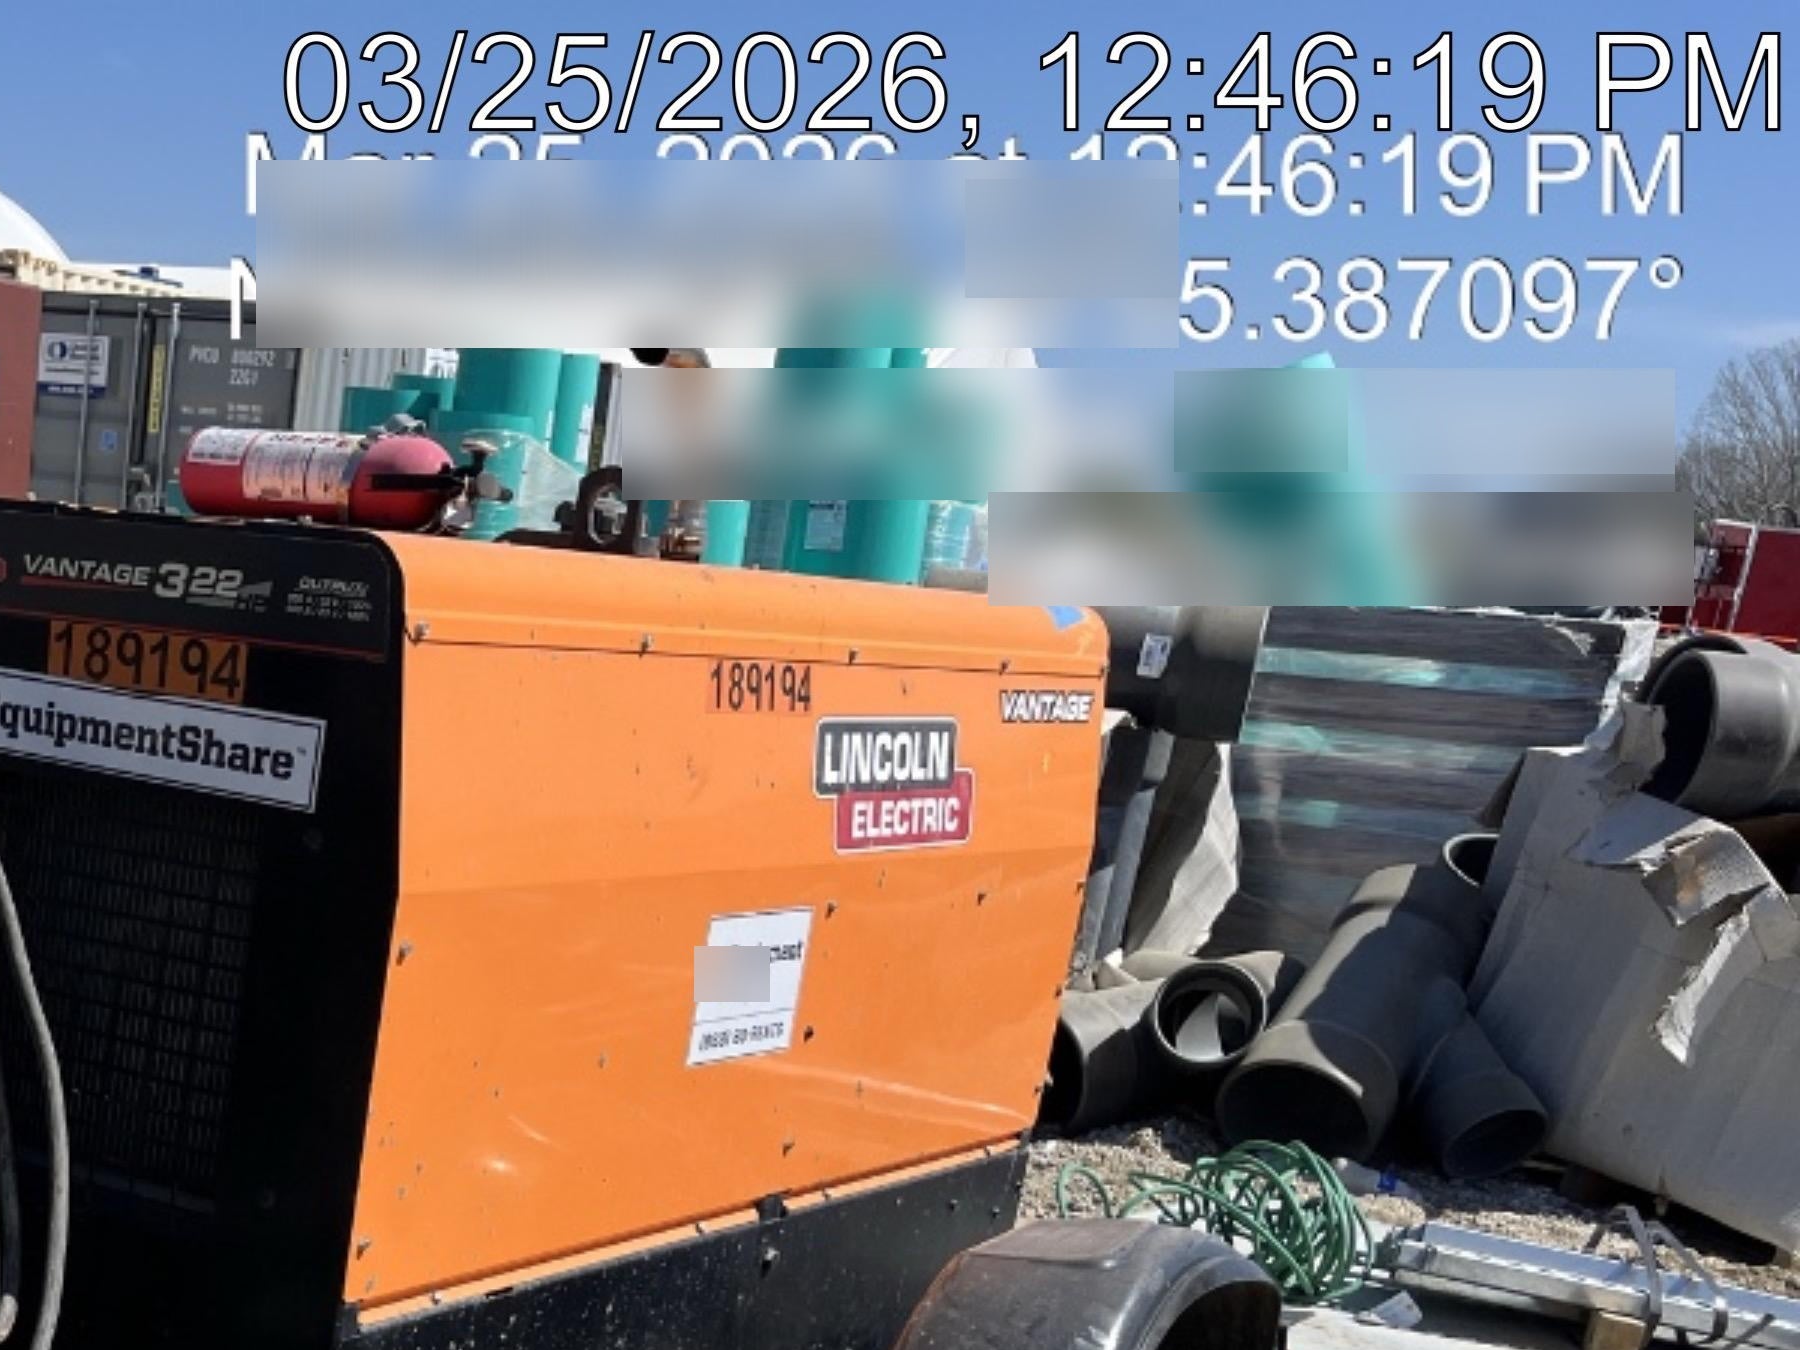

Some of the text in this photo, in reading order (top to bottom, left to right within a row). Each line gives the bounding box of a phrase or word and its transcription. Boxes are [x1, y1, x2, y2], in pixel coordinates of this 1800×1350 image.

[23, 554, 244, 598] VANTAGE 322
[53, 623, 242, 698] 189194
[710, 660, 813, 713] 189194
[1000, 690, 1094, 722] VANTAGE
[821, 730, 950, 785] LINCOLN
[851, 796, 960, 839] ELECTRIC
